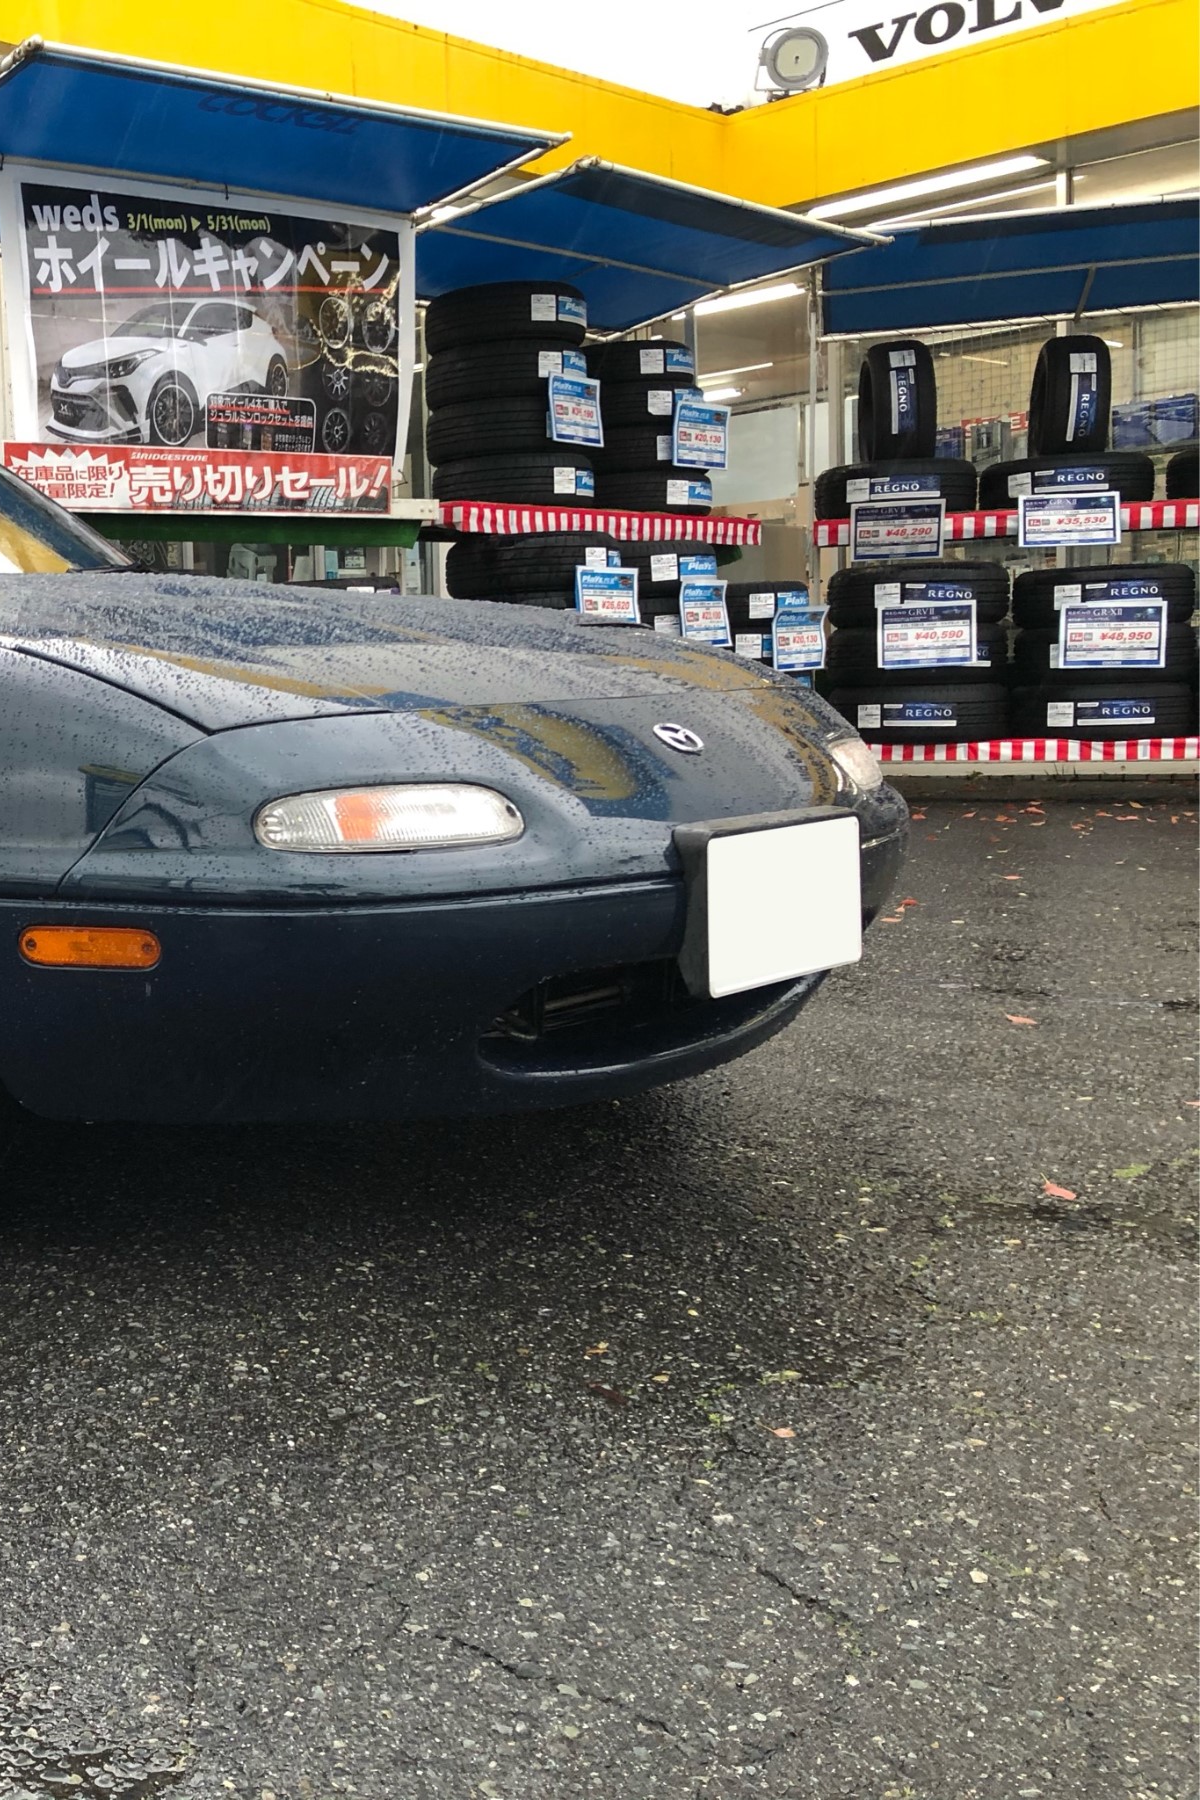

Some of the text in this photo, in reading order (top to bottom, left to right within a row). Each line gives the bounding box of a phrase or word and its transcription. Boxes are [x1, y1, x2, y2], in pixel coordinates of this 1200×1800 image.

[848, 0, 1068, 62] VOL
[32, 194, 270, 232] weds 3/1(mon) 5/31(mon)
[33, 236, 390, 292] ホイールキャンペーン
[1077, 393, 1090, 438] REGNO
[131, 451, 208, 462] BRIDGESTONE
[13, 465, 124, 482] 在庫品に限り
[1057, 473, 1105, 482] REGNO
[129, 464, 389, 504] 売り切りセール!
[875, 483, 920, 493] REGNO
[1056, 516, 1107, 525] ¥35,530
[886, 527, 933, 537] ¥48,290
[928, 590, 972, 599] REGNO
[1111, 586, 1159, 596] REGNO
[915, 630, 964, 640] ¥40,590
[1100, 631, 1152, 641] ¥48,950
[905, 709, 952, 717] REGNO
[1102, 706, 1151, 715] REGNO
